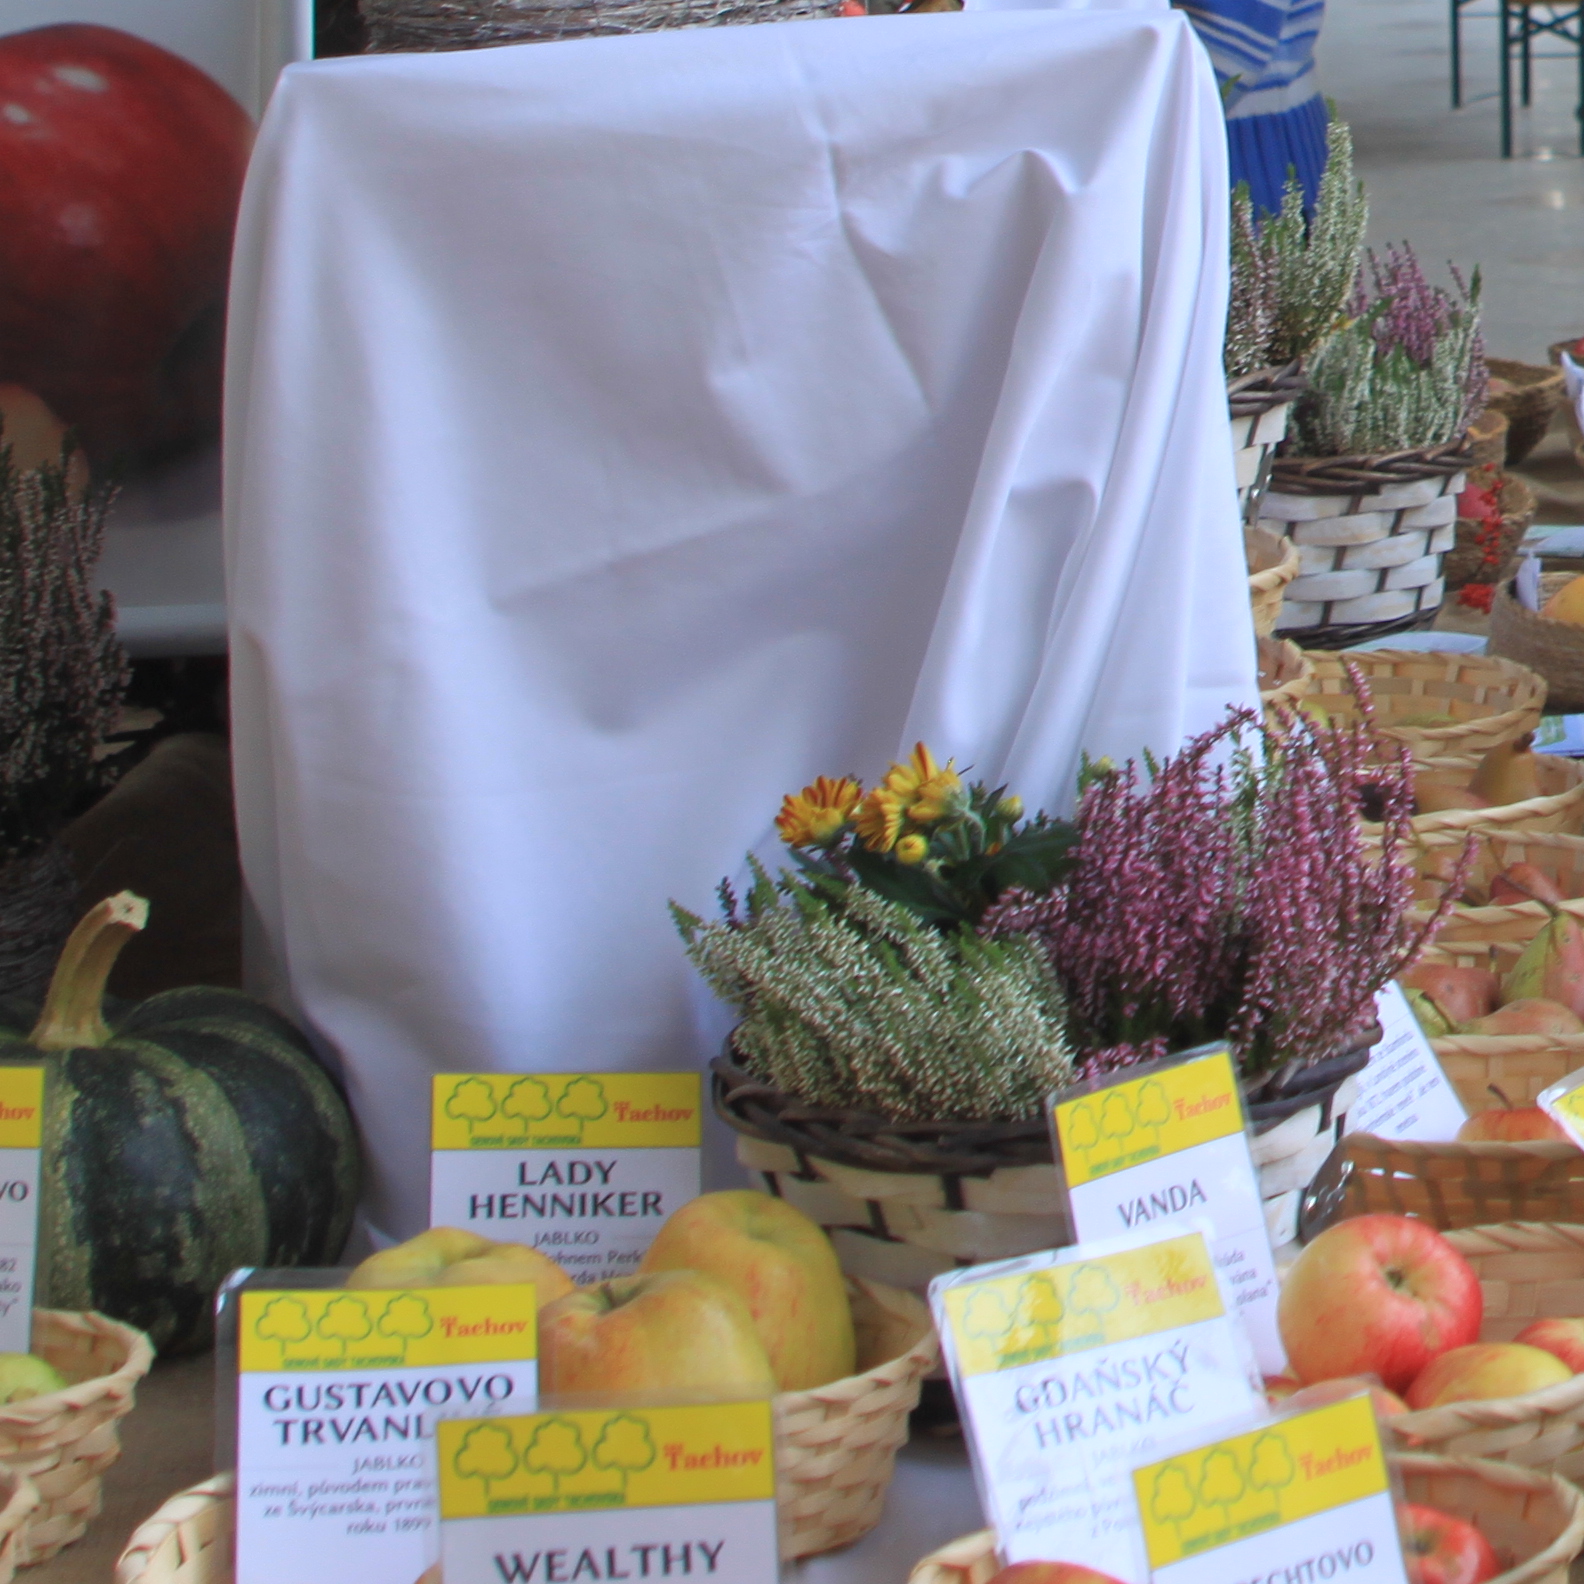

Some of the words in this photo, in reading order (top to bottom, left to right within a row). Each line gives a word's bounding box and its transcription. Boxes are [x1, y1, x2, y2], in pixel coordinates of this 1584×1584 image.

[613, 1101, 695, 1122] Tachov
[518, 1159, 618, 1187] LADY
[469, 1190, 664, 1219] HENNIKER
[1117, 1178, 1209, 1230] VANDA
[532, 1230, 600, 1248] JABLKO
[543, 1250, 601, 1266] ohnem
[439, 1315, 529, 1340] Tachov
[1015, 1339, 1193, 1414] GDAŇSKÝ
[263, 1372, 515, 1413] GUSTAVOVO
[1033, 1376, 1196, 1449] HRANÁČ
[353, 1453, 424, 1476] JABLKO
[662, 1443, 765, 1471] Tachov
[494, 1539, 726, 1584] WEALTHY
[1236, 1538, 1376, 1584] CHTOVO
